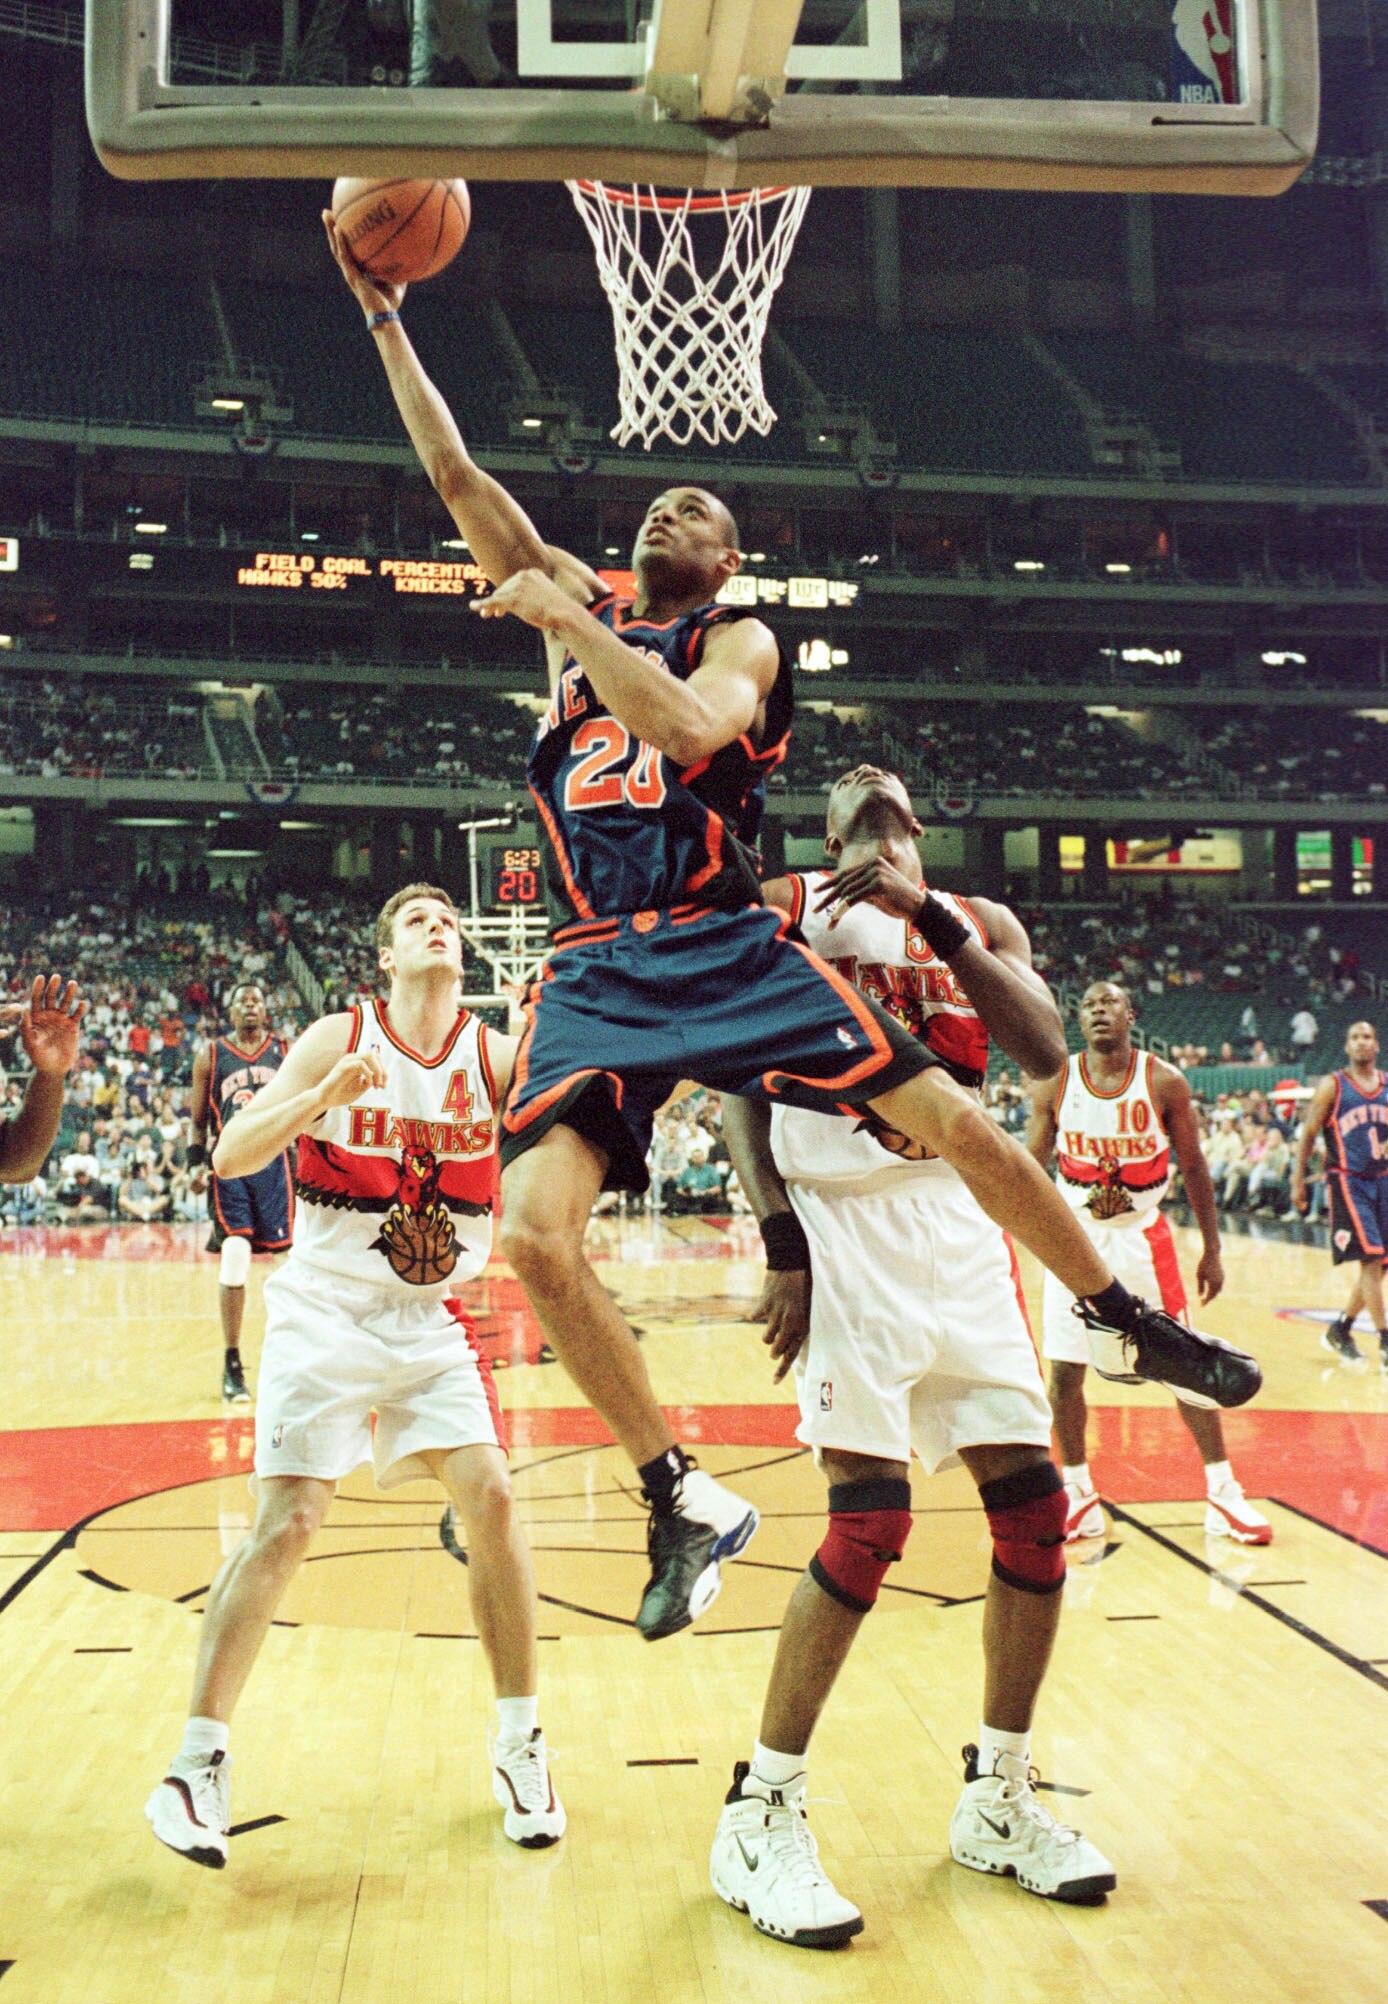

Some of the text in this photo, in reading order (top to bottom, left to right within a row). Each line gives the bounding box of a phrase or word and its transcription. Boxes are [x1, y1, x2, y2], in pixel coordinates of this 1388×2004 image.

[1180, 84, 1215, 104] NBA
[238, 568, 490, 595] HAWKS 50% KNICKS 7
[256, 553, 488, 580] FIELD GOAL PERCENTAG
[564, 715, 668, 812] 20
[504, 850, 541, 868] 6:23
[498, 871, 537, 901] 20
[904, 918, 937, 964] 5
[221, 1065, 279, 1103] NEW YOR
[441, 1069, 475, 1122] 4
[347, 1106, 494, 1154] HAWKS
[1116, 1098, 1150, 1135] 10
[1339, 1104, 1368, 1137] NEW
[1064, 1130, 1158, 1158] HAWKS
